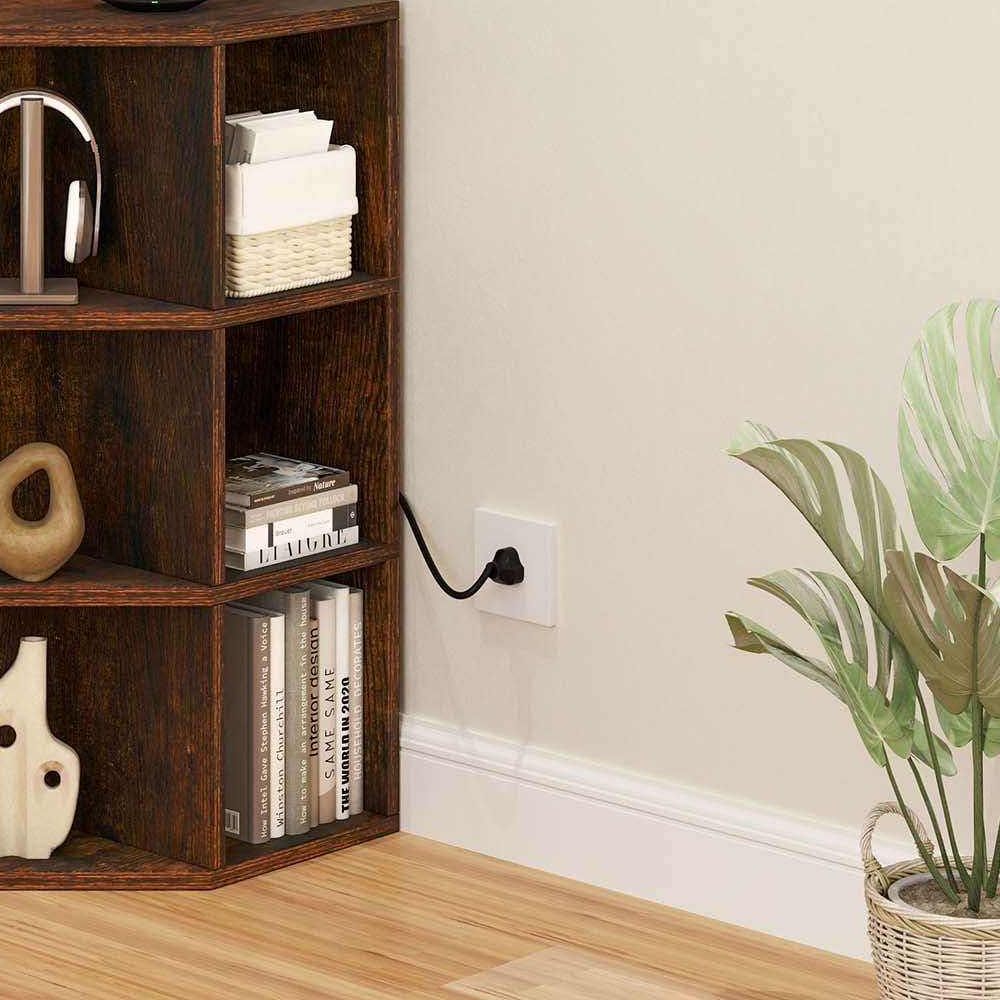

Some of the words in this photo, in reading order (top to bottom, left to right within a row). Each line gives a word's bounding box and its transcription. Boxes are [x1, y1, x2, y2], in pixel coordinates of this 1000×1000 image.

[313, 479, 336, 491] Nature
[300, 655, 307, 665] in
[310, 627, 319, 688] design
[353, 622, 362, 697] DECORATES
[260, 666, 269, 708] Hawking
[325, 668, 335, 717] SAME
[341, 677, 350, 714] 2020
[261, 712, 269, 753] Stephen
[276, 690, 284, 761] Churchill
[309, 694, 319, 757] Interior
[341, 716, 350, 732] IN
[353, 704, 362, 780] HOUSEHOLD
[301, 742, 307, 753] an
[325, 730, 335, 779] SAME
[341, 734, 350, 785] WORLD
[260, 788, 268, 814] Intel
[276, 769, 284, 827] Winston
[301, 789, 307, 801] to
[341, 787, 350, 813] THE
